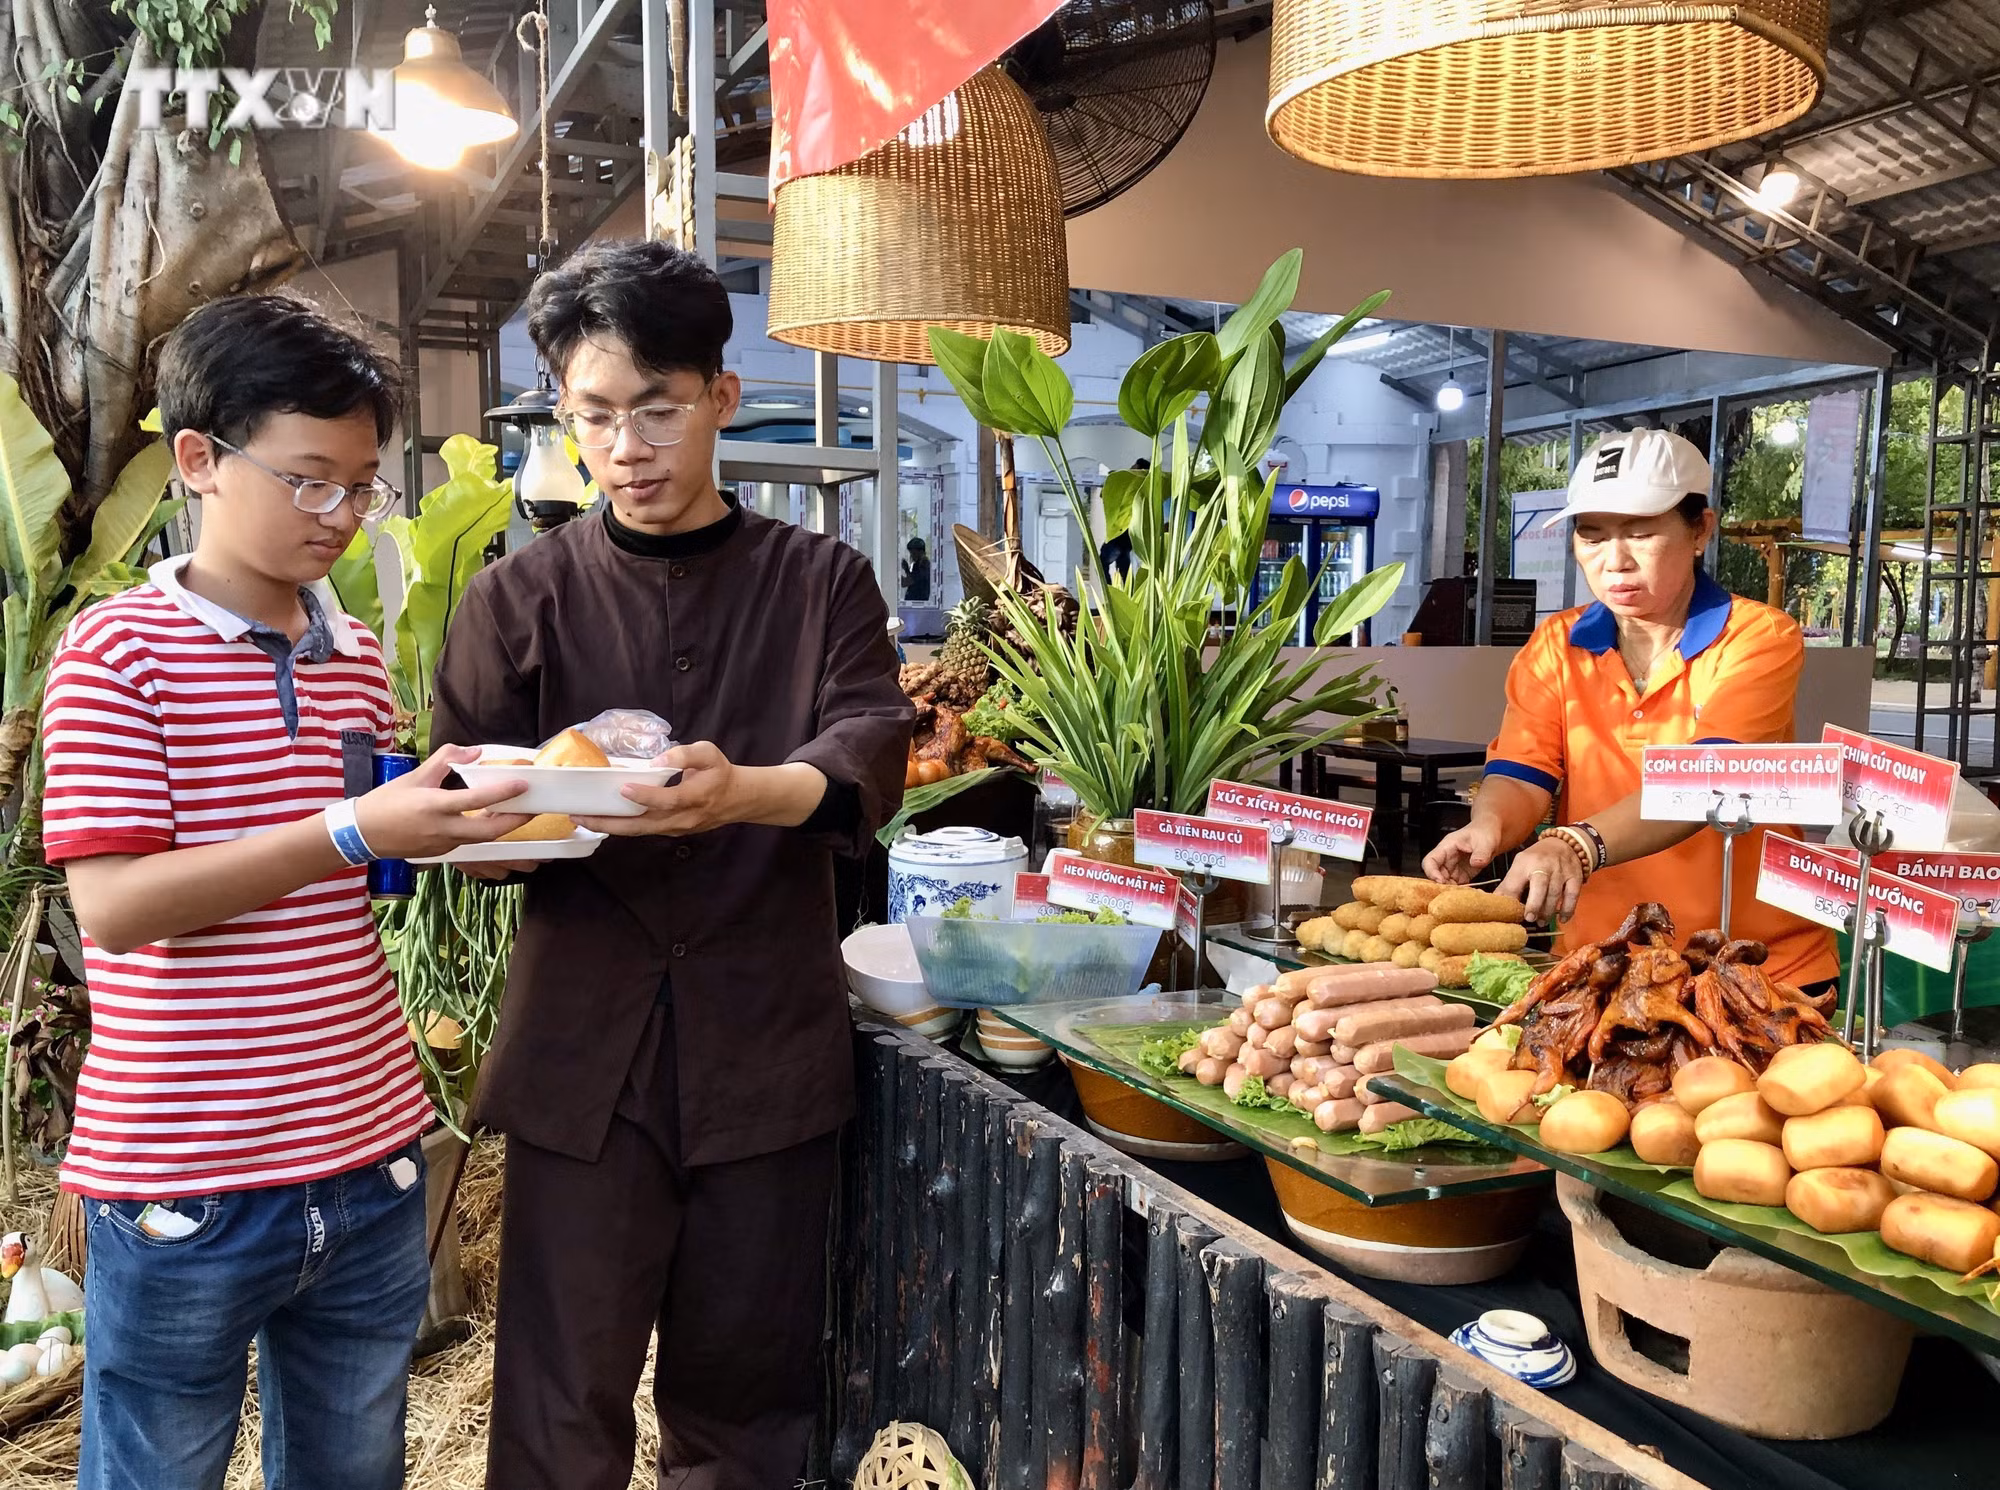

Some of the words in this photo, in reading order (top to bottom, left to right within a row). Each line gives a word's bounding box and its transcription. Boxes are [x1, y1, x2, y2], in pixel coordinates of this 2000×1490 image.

[1310, 494, 1350, 510] pepsi
[1645, 758, 1677, 773] CƠM
[1679, 754, 1726, 773] CHIÊN
[1728, 758, 1787, 773] DƯƠNG
[1790, 753, 1839, 774] CHÂU
[1843, 745, 1870, 766] CHIM
[1870, 751, 1893, 774] CÚT
[1893, 762, 1927, 785] QUAY
[1216, 788, 1244, 806] XÚC
[1245, 794, 1280, 813] XÍCH
[1281, 802, 1322, 821] XÔNG
[1324, 812, 1364, 829] KHÓI
[1158, 820, 1173, 835] GÀ
[1174, 823, 1200, 838] XIÊN
[1201, 829, 1226, 842] RAU
[1227, 830, 1243, 844] CỦ
[1309, 833, 1337, 849] cây
[1063, 864, 1085, 877] HEO
[1086, 869, 1125, 886] NƯỚNG
[1125, 875, 1149, 892] MẬT
[1149, 881, 1166, 894] MÈ
[1789, 855, 1823, 878] BÚN
[1825, 868, 1860, 893] THỊT
[1897, 858, 1954, 879] BÁNH
[1958, 865, 2000, 880] BAO
[308, 1206, 325, 1253] JEANS
